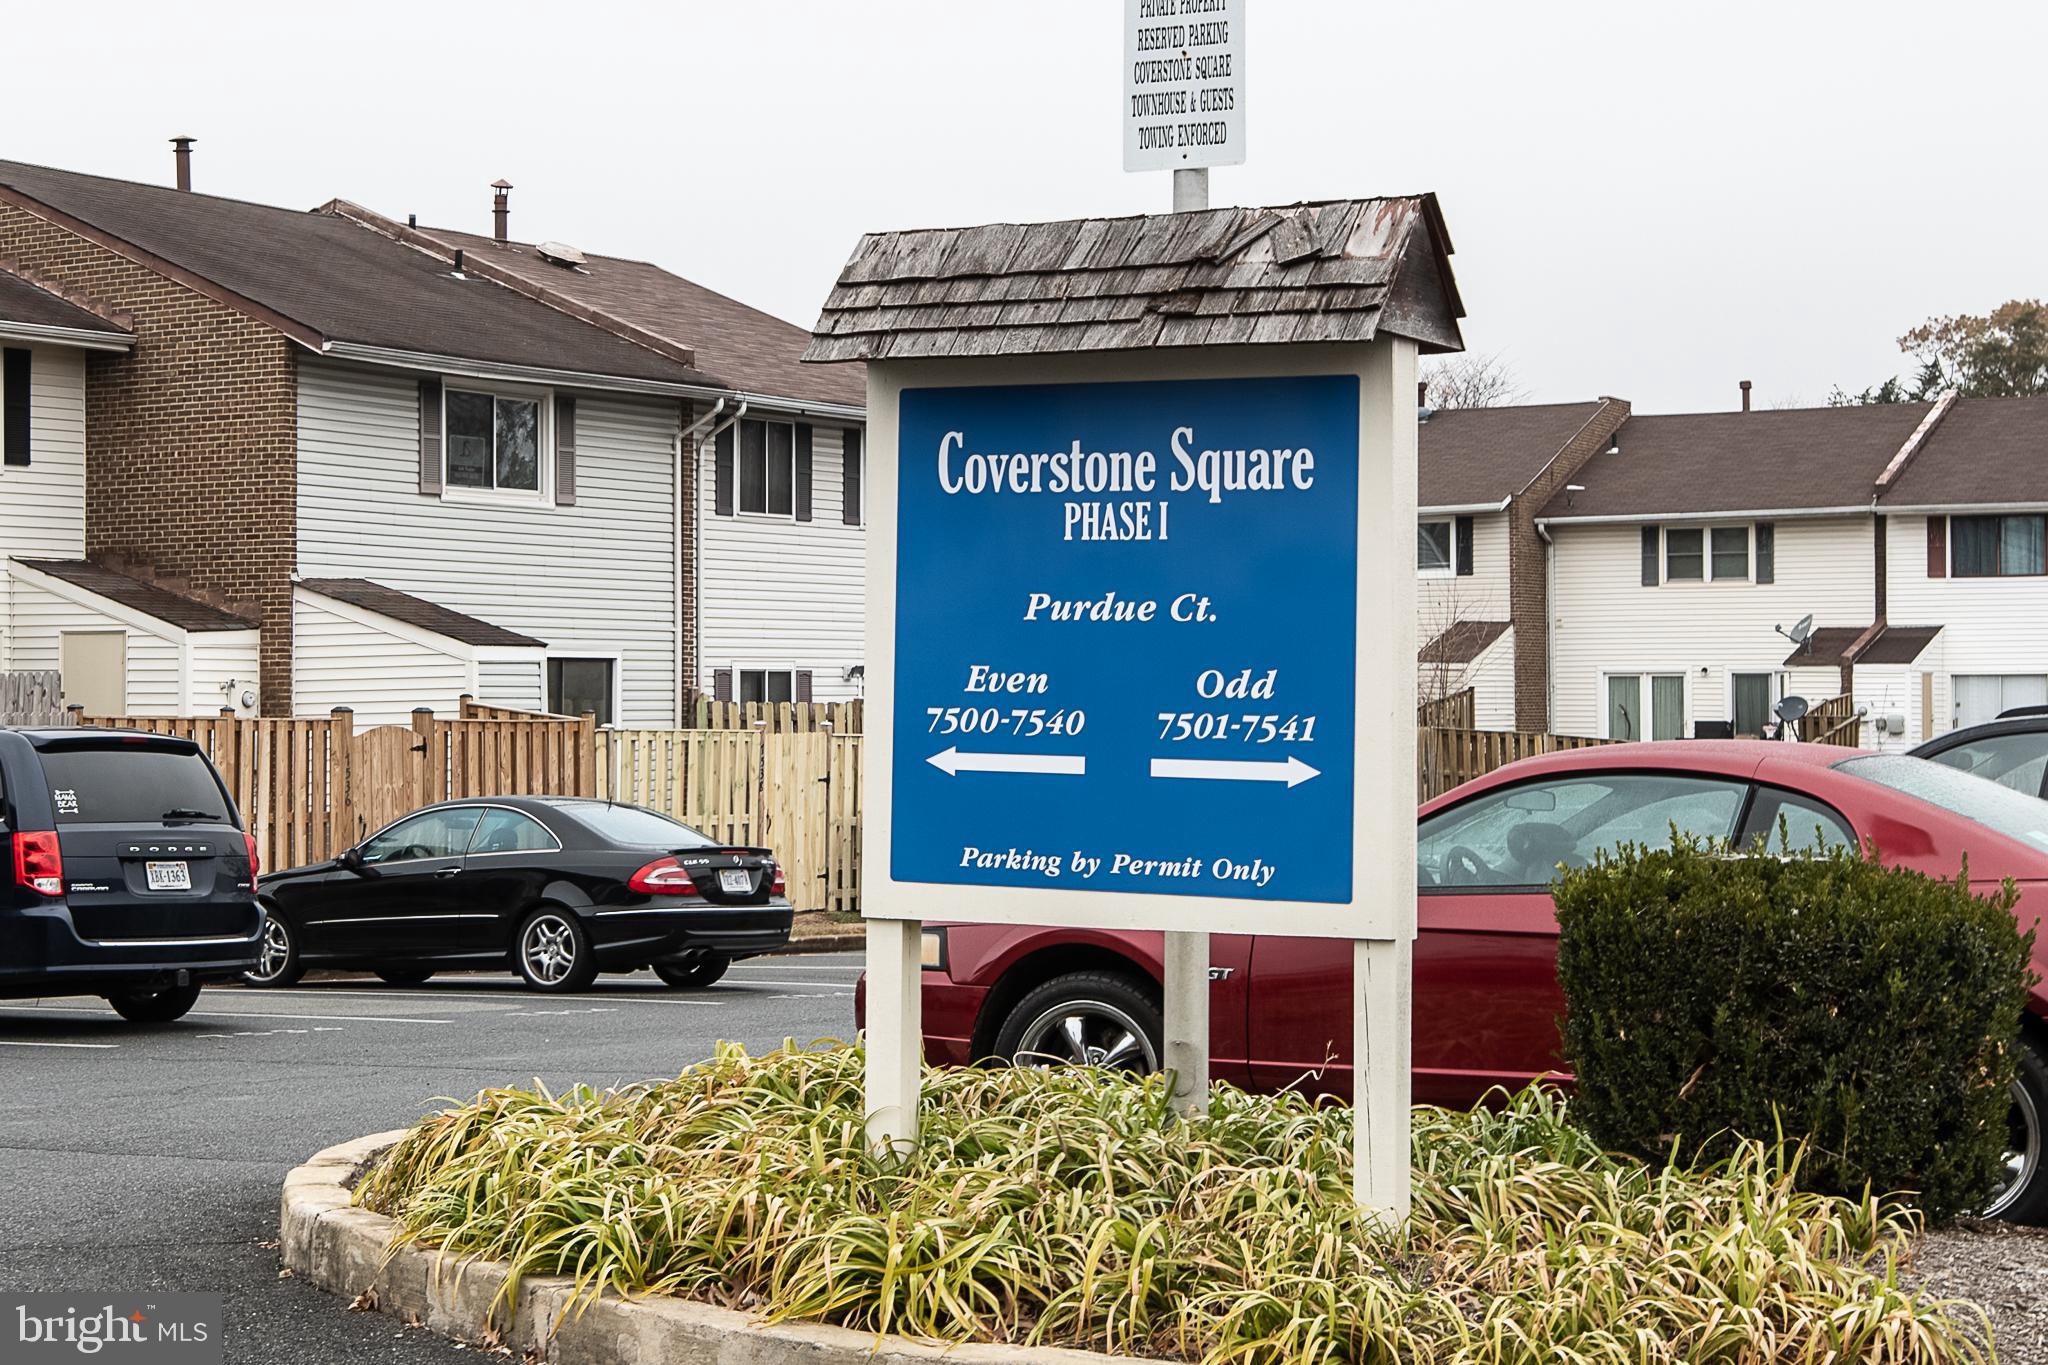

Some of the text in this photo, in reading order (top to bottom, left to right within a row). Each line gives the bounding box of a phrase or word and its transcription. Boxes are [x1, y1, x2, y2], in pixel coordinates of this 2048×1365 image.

[1140, 0, 1176, 18] PRIVATE
[1137, 21, 1228, 51] RESERVED PARKING
[1134, 54, 1232, 85] COVERSTONE SQUARE
[1131, 88, 1234, 117] TOWNHOUSE & GUESTS
[1138, 121, 1227, 150] TOWING ENFORCED
[938, 426, 1315, 504] Coverstone Square
[1064, 501, 1169, 541] PHASE I
[1023, 592, 1218, 623] Purdue Ct.
[964, 665, 1049, 694] Even
[1196, 668, 1279, 700] Odd
[927, 706, 1086, 737] 7500-7540
[1157, 712, 1317, 744] 7501-7541
[959, 846, 1276, 887] Parking by Permit Only
[1208, 966, 1235, 980] GT
